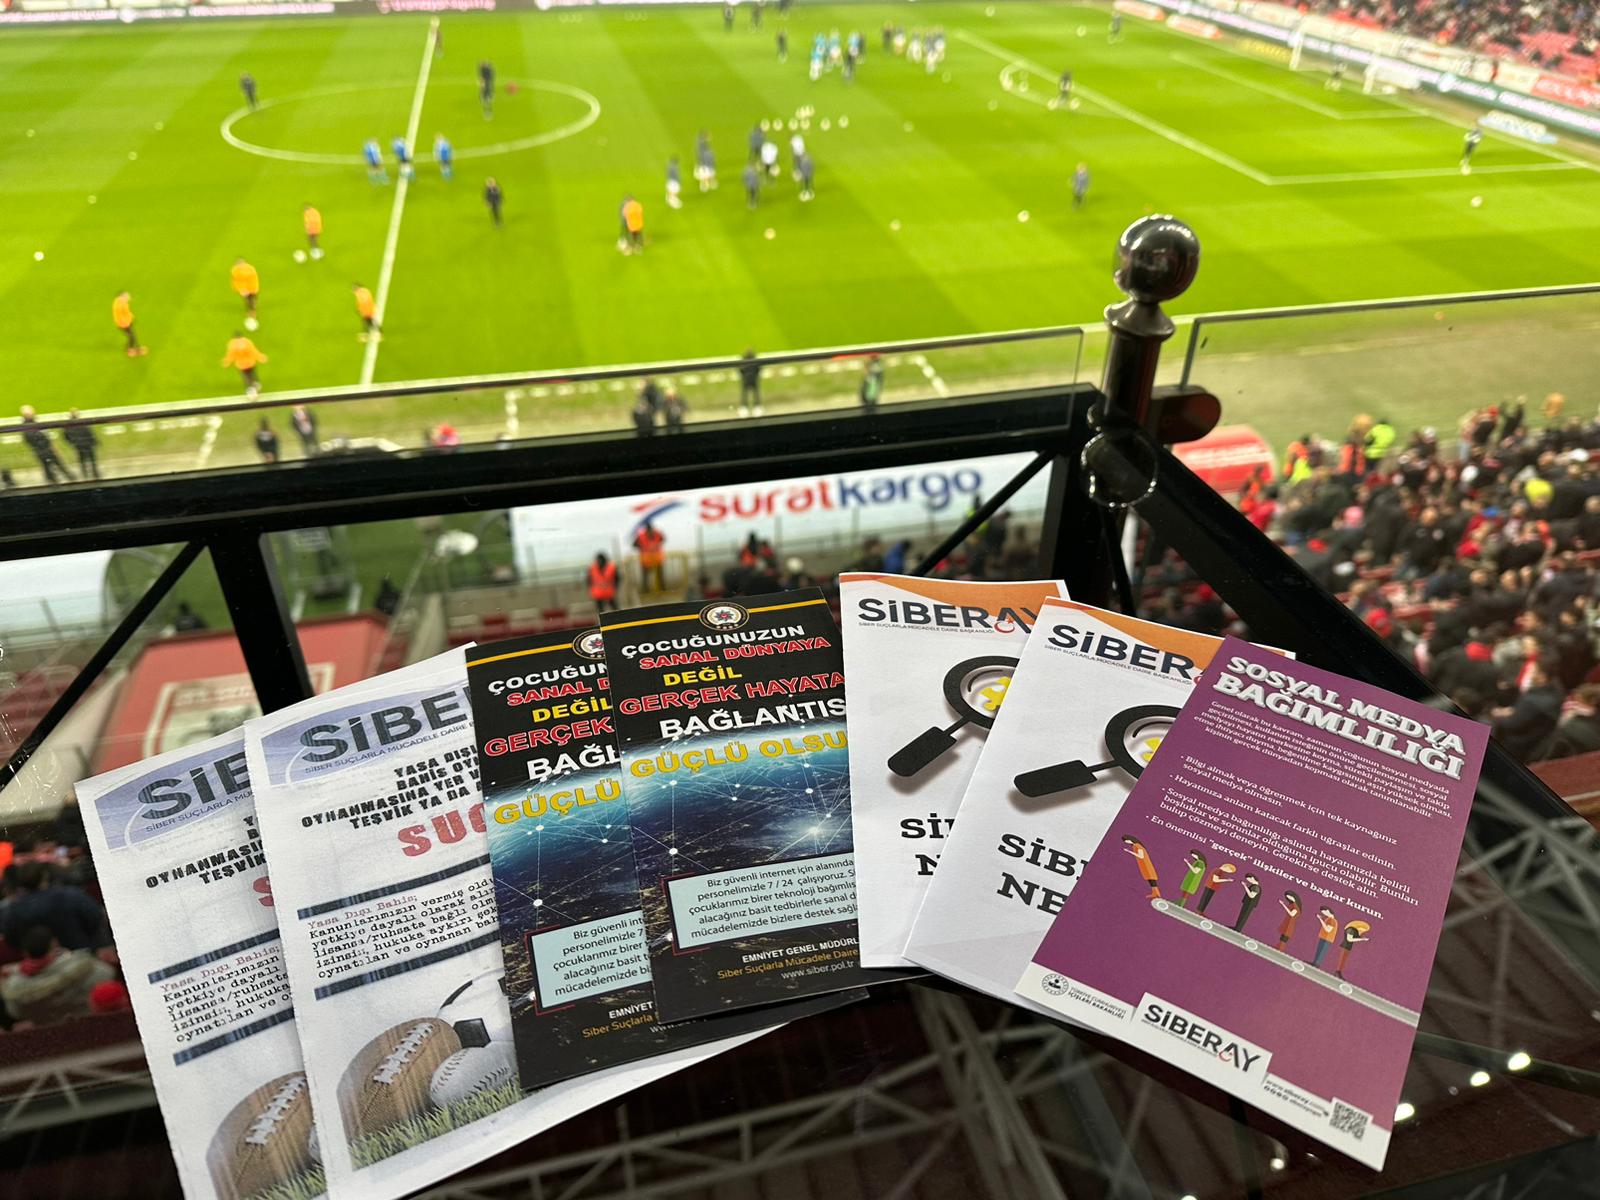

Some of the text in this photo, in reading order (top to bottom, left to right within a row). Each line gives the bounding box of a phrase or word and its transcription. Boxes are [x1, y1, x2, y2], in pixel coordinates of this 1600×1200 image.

[621, 625, 805, 659] ÇOCUĞUNUZUN
[639, 636, 832, 670] SANAL DÜNYAYA
[1048, 624, 1194, 680] SİBER
[619, 671, 845, 715] GERÇEK HAYATA
[662, 666, 742, 686] DEĞİL
[507, 682, 592, 706] SANAL
[532, 696, 613, 723] DEĞİL
[1227, 656, 1467, 755] SOSYAL MEDYA
[299, 687, 473, 763] SİBE
[659, 698, 846, 740] BAĞLANTIS
[1212, 672, 1465, 780] BAĞIMLILIĞI
[484, 717, 615, 756] GERÇEK
[1211, 700, 1234, 712] Genel
[1234, 710, 1259, 721] olarak
[1381, 765, 1409, 777] sosyal
[1409, 775, 1450, 793] medyada
[393, 755, 440, 779] YASA
[527, 743, 621, 781] BAĞL
[630, 730, 848, 778] GÜÇLÜ OLSU
[396, 766, 448, 791] BAHİS
[1181, 763, 1283, 807] sosyal medya olmasın.
[1303, 764, 1340, 781] kopması
[1341, 779, 1369, 793] olarak
[300, 773, 464, 829] OYNANMASINA YER
[349, 784, 470, 831] TEŞVİK YA DA
[494, 779, 622, 825] GÜÇLÜ
[1184, 755, 1397, 844] Bilgi almak veya öğrenmek için tek kaynağınız
[1427, 796, 1451, 809] takip
[1173, 775, 1396, 870] Hayatınıza anlam katacak farklı uğraşlar edinin.
[1158, 801, 1378, 899] bulup çözmeyi deneyin. Gerekirse destek alın.
[1162, 795, 1419, 906] boşluklar ve sorunlar olduğuna ipucu olabilir. Bunları
[1165, 788, 1411, 893] Sosyal medya bağımlılığı aslında hayatınızda belirli
[706, 858, 854, 888] Biz güvenli internet için alanında
[1150, 816, 1164, 826] En
[1164, 822, 1207, 844] önemlisi
[1251, 859, 1295, 882] ilişkiler
[1295, 879, 1308, 888] ve
[1309, 883, 1345, 903] bağlar
[1345, 899, 1383, 920] kurun.
[687, 881, 857, 915] çocuklarımız birer teknoloji bağımlıs
[697, 872, 847, 902] personelimizle 7 / 24 çalışıyoruz.
[308, 889, 464, 939] Kanunlarımızın vermiş
[369, 896, 465, 932] dayalı olarak
[430, 907, 467, 924] bağlı
[690, 906, 836, 938] mücadelemizde bizlere destek
[698, 893, 848, 924] alacağınız basit tedbirlerle sanal
[373, 915, 472, 951] hukuka aykırı
[394, 925, 471, 955] ve oynanan
[562, 927, 644, 956] personelimizle 7
[572, 919, 627, 940] Biz güvenli
[552, 941, 643, 972] çocuklarımız birer
[562, 953, 641, 980] alacağınız basit
[741, 948, 784, 963] EMNİYET
[785, 942, 819, 955] GENEL
[743, 960, 784, 974] Suçlarla
[784, 952, 832, 967] Mücadele
[832, 948, 859, 959] Daire
[780, 959, 855, 979] www.siber.pol.tr
[229, 965, 279, 988] dayalı
[554, 969, 638, 996] mücadelemizde
[258, 998, 276, 1010] ve
[608, 999, 654, 1019] EMNİYET
[611, 1014, 653, 1030] Suçlarla
[1144, 1003, 1261, 1073] SİBERAY
